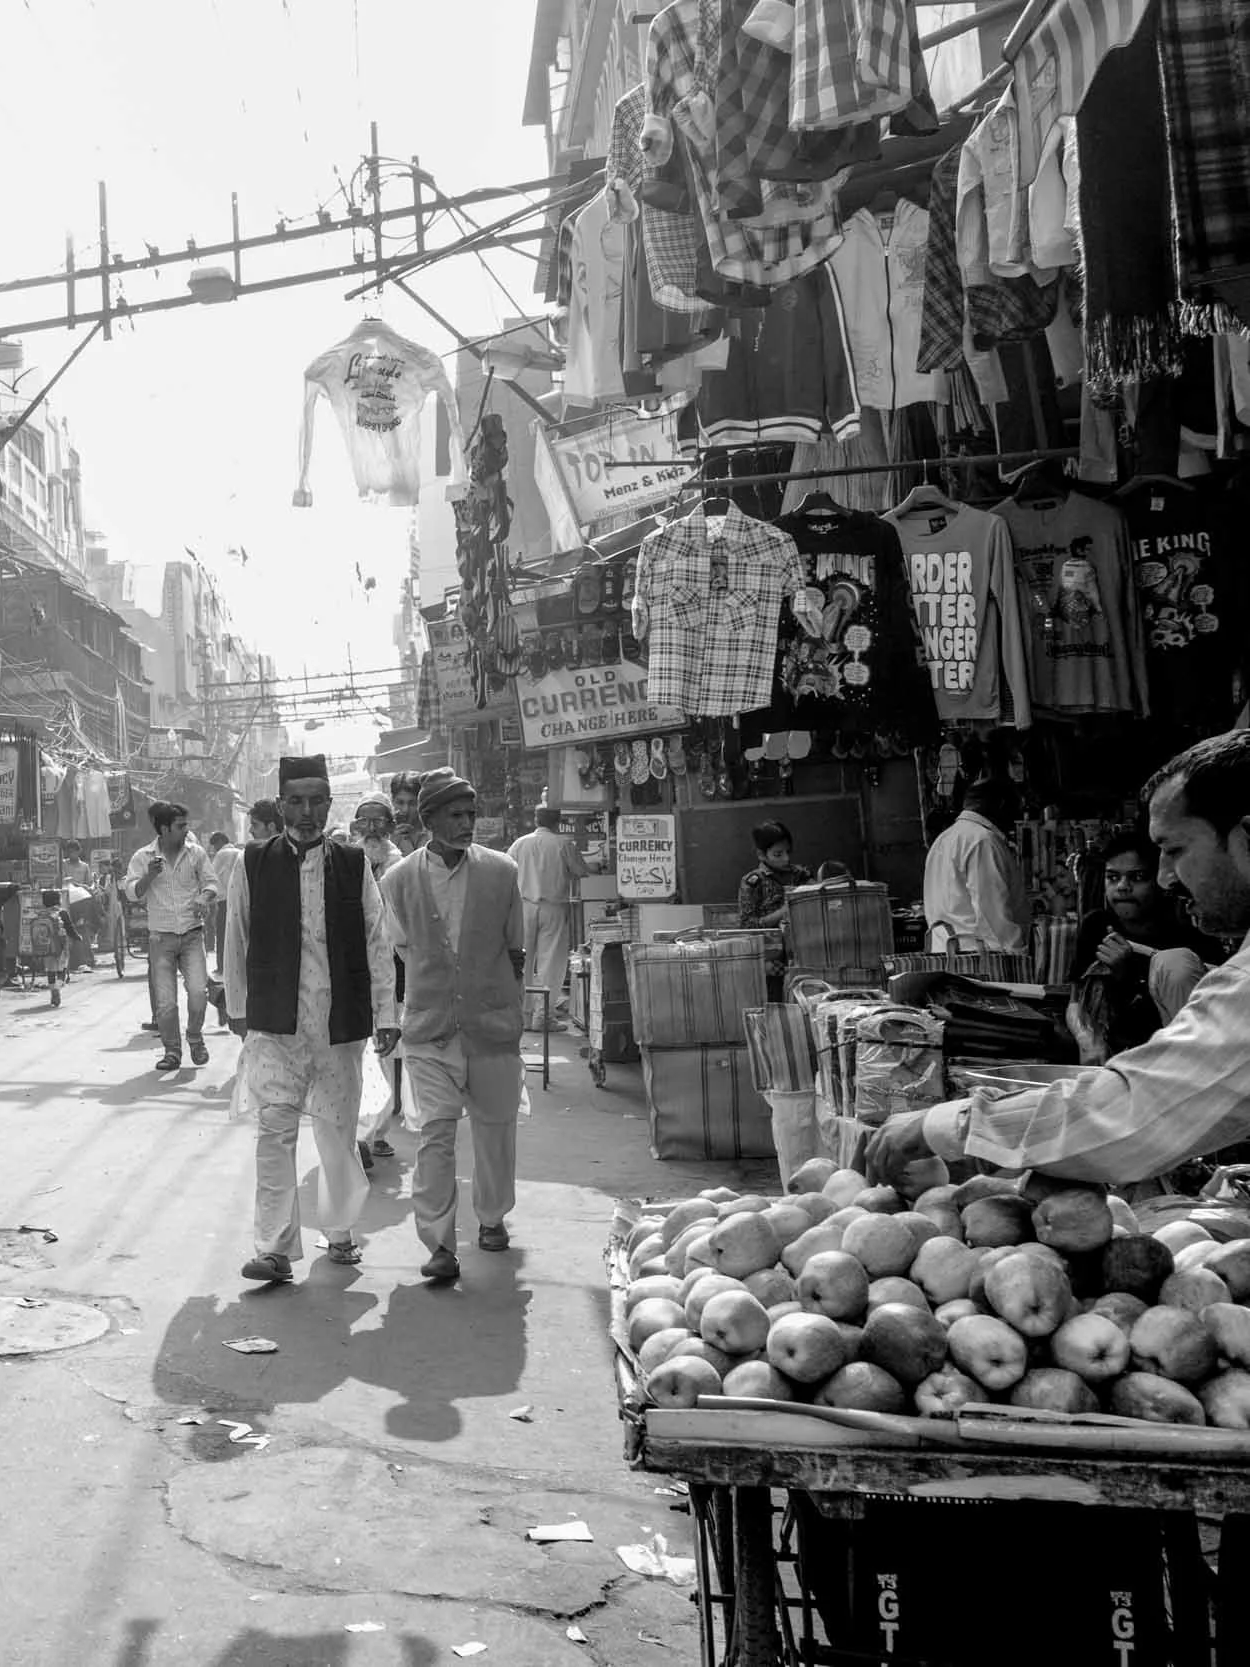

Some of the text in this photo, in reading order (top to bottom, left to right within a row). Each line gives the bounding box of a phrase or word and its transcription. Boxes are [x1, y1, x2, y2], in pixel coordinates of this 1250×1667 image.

[1156, 532, 1211, 558] KING
[910, 551, 972, 593] RDER
[575, 671, 616, 687] OLD
[522, 678, 648, 718] CURRENC
[540, 707, 658, 738] CHANGE HERE
[619, 840, 672, 852] CURRENCY
